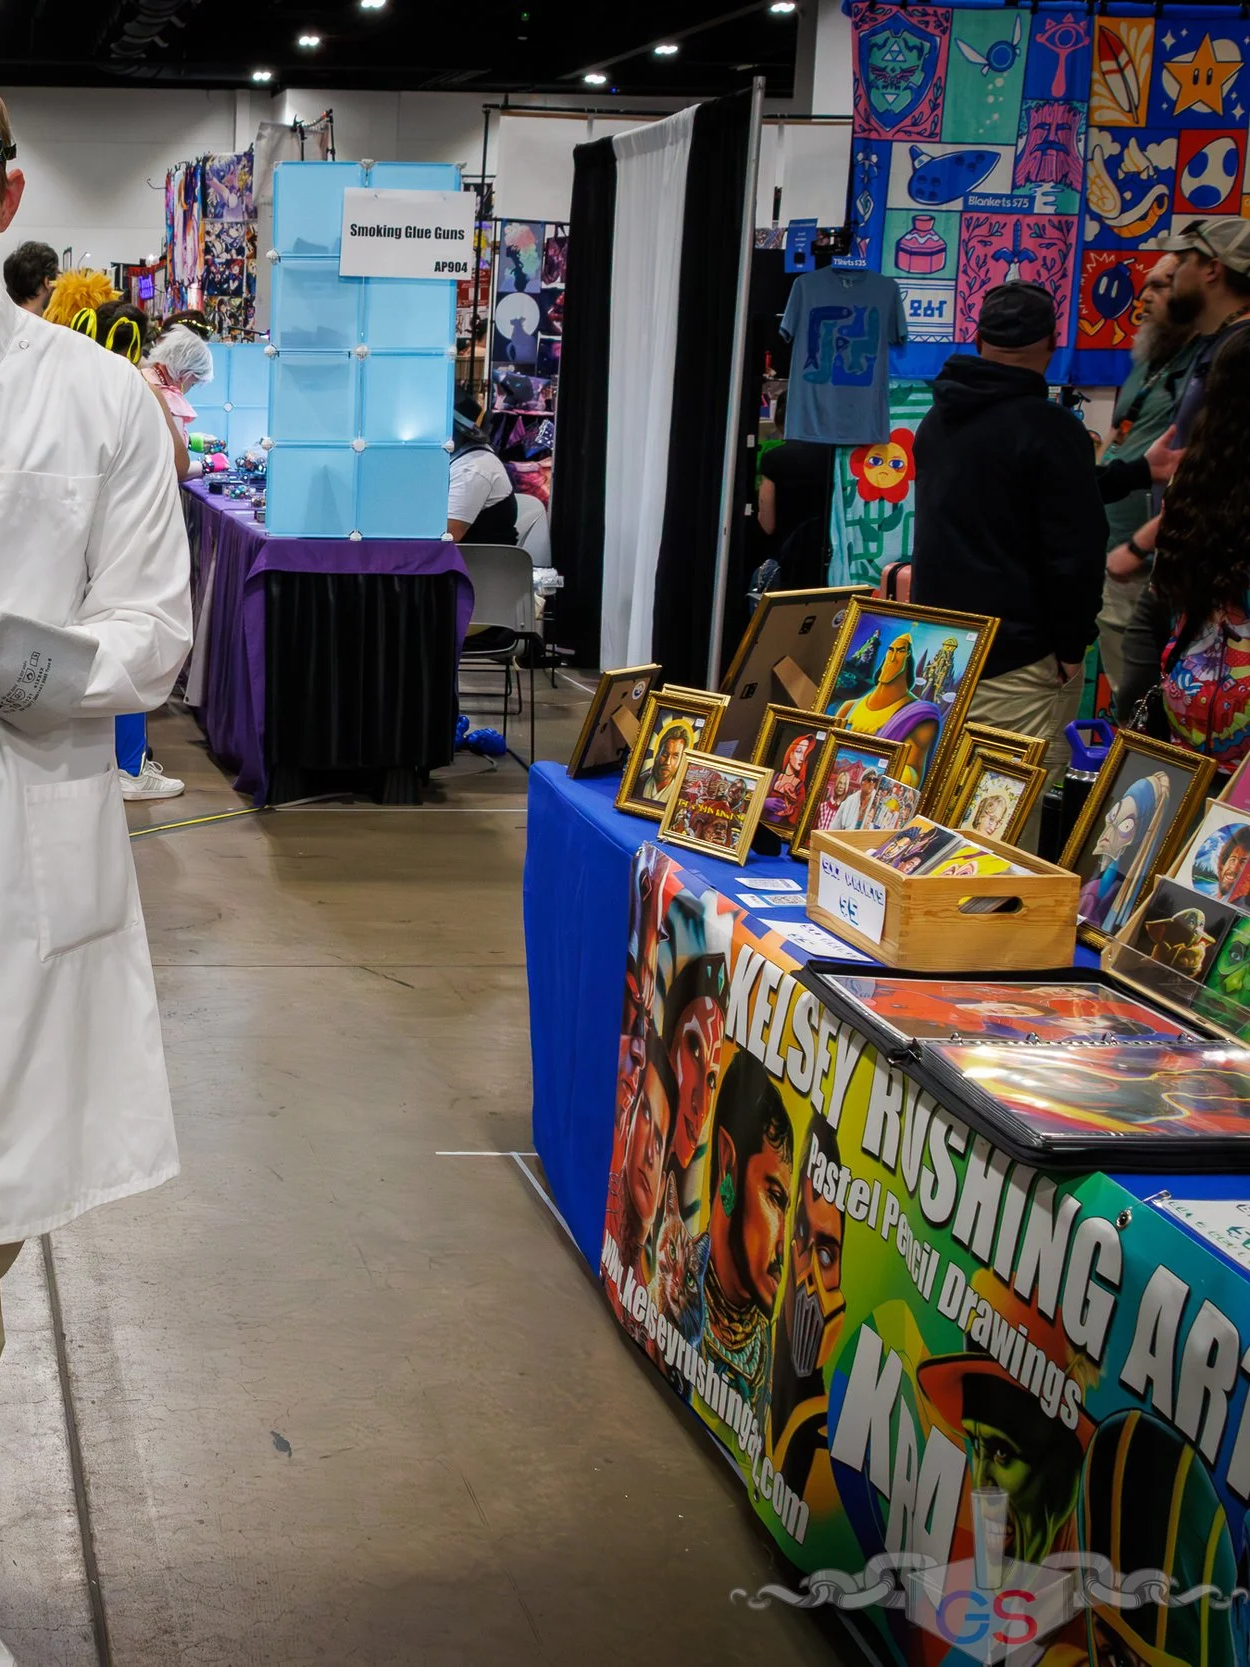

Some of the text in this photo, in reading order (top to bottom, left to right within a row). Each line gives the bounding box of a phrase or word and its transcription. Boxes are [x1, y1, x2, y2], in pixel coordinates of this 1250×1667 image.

[968, 194, 1011, 208] Blankets
[350, 224, 465, 241] Smoking Glue Guns
[434, 261, 468, 273] AP904
[725, 943, 869, 1131] KELSEY
[861, 1053, 1123, 1362] RUSHING
[806, 1132, 1084, 1431] Pastel Pencil Drawings
